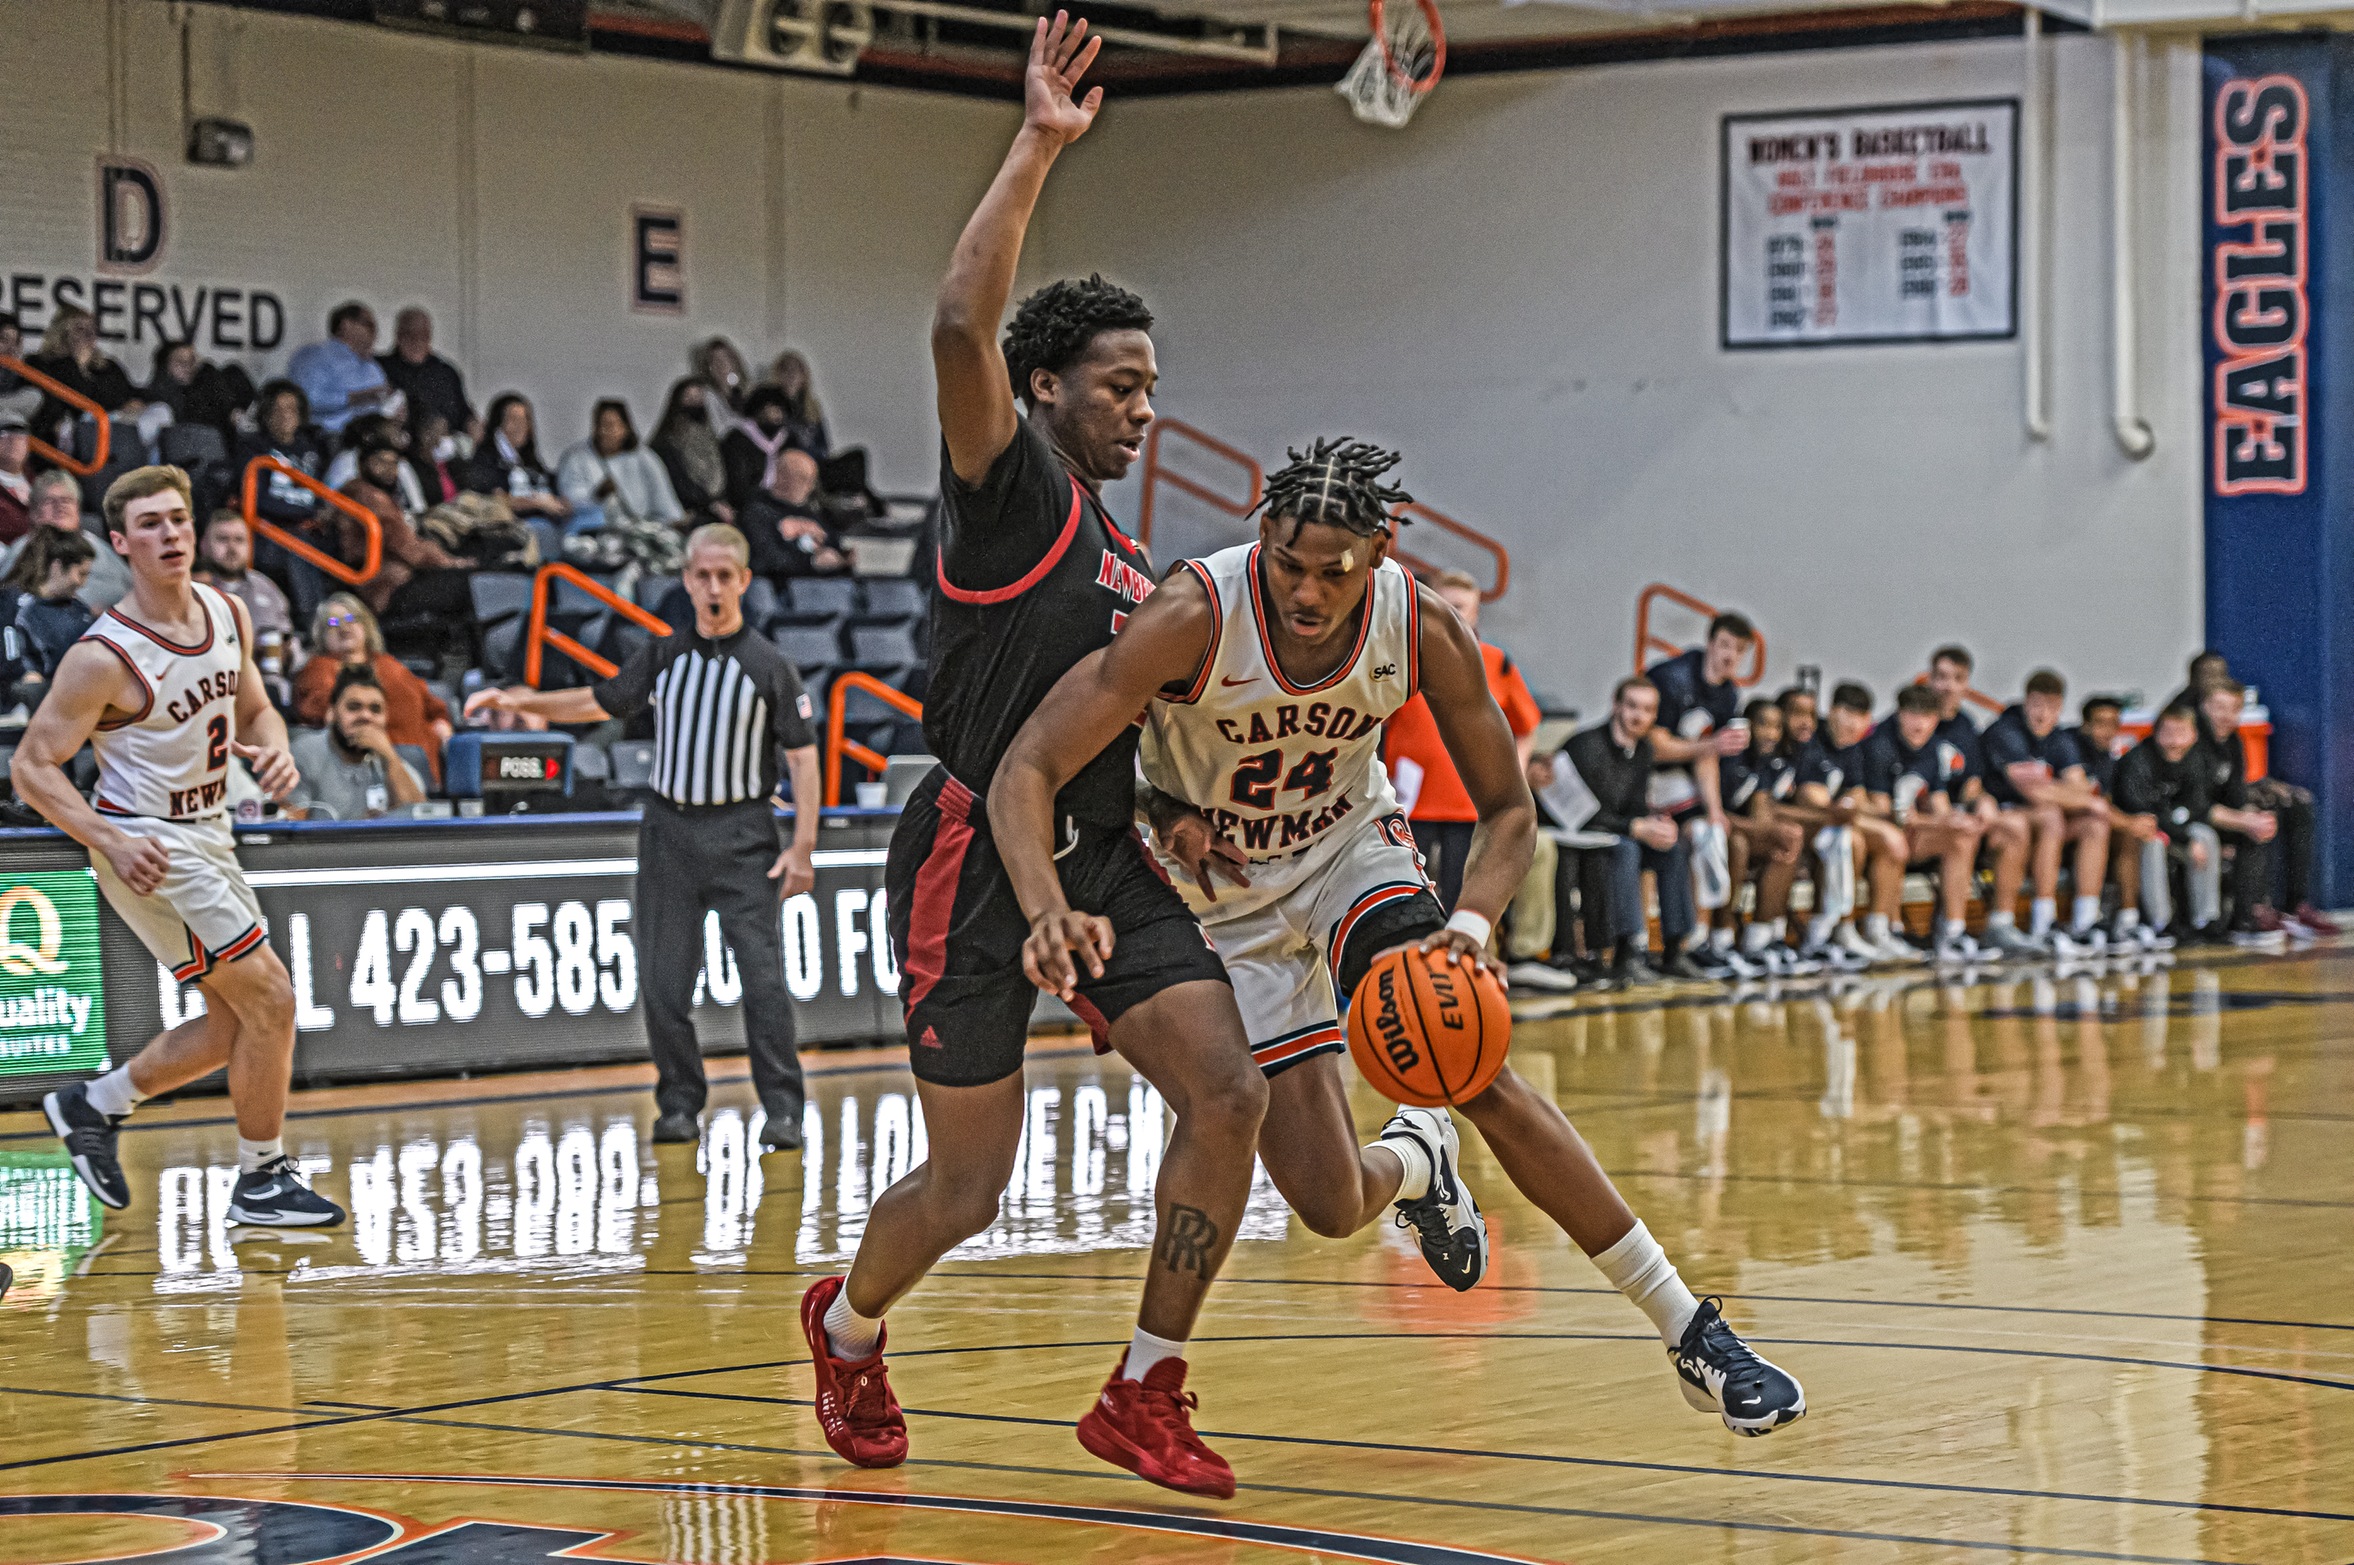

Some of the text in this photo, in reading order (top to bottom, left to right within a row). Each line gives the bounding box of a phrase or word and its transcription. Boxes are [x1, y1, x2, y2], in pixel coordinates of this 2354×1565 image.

[1749, 122, 1990, 164] WOMEN'S BASKETBALL
[99, 159, 164, 270] D
[635, 211, 682, 309] E
[2214, 75, 2309, 496] EAGLES
[0, 274, 284, 350] ESERVED
[1373, 663, 1397, 680] SAC
[206, 713, 229, 772] 2
[1229, 746, 1339, 811] 24
[1375, 967, 1420, 1075] Wilson
